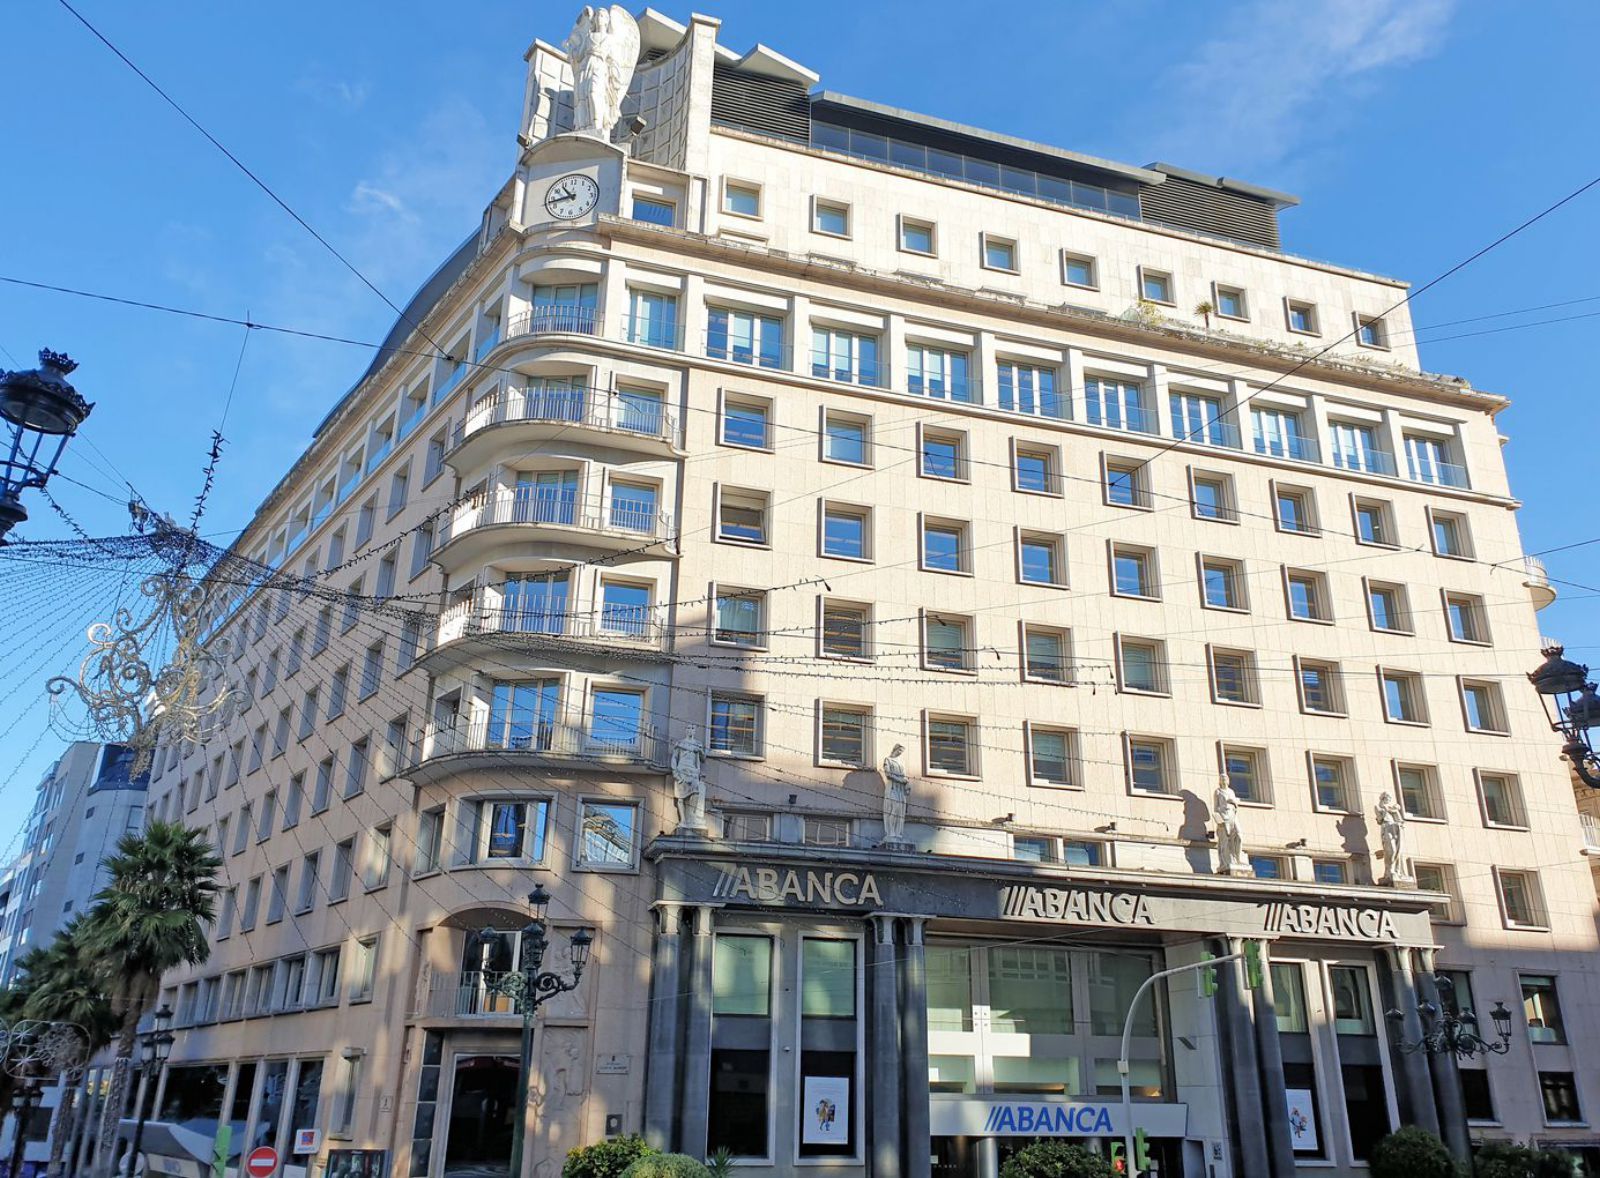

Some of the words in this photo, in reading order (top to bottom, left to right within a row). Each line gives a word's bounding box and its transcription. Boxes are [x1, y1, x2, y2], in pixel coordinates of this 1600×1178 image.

[732, 867, 883, 906] ABANCA
[1021, 886, 1156, 924] ABANCA
[1279, 903, 1401, 938] ABANCA
[996, 1106, 1113, 1133] ABANCA
